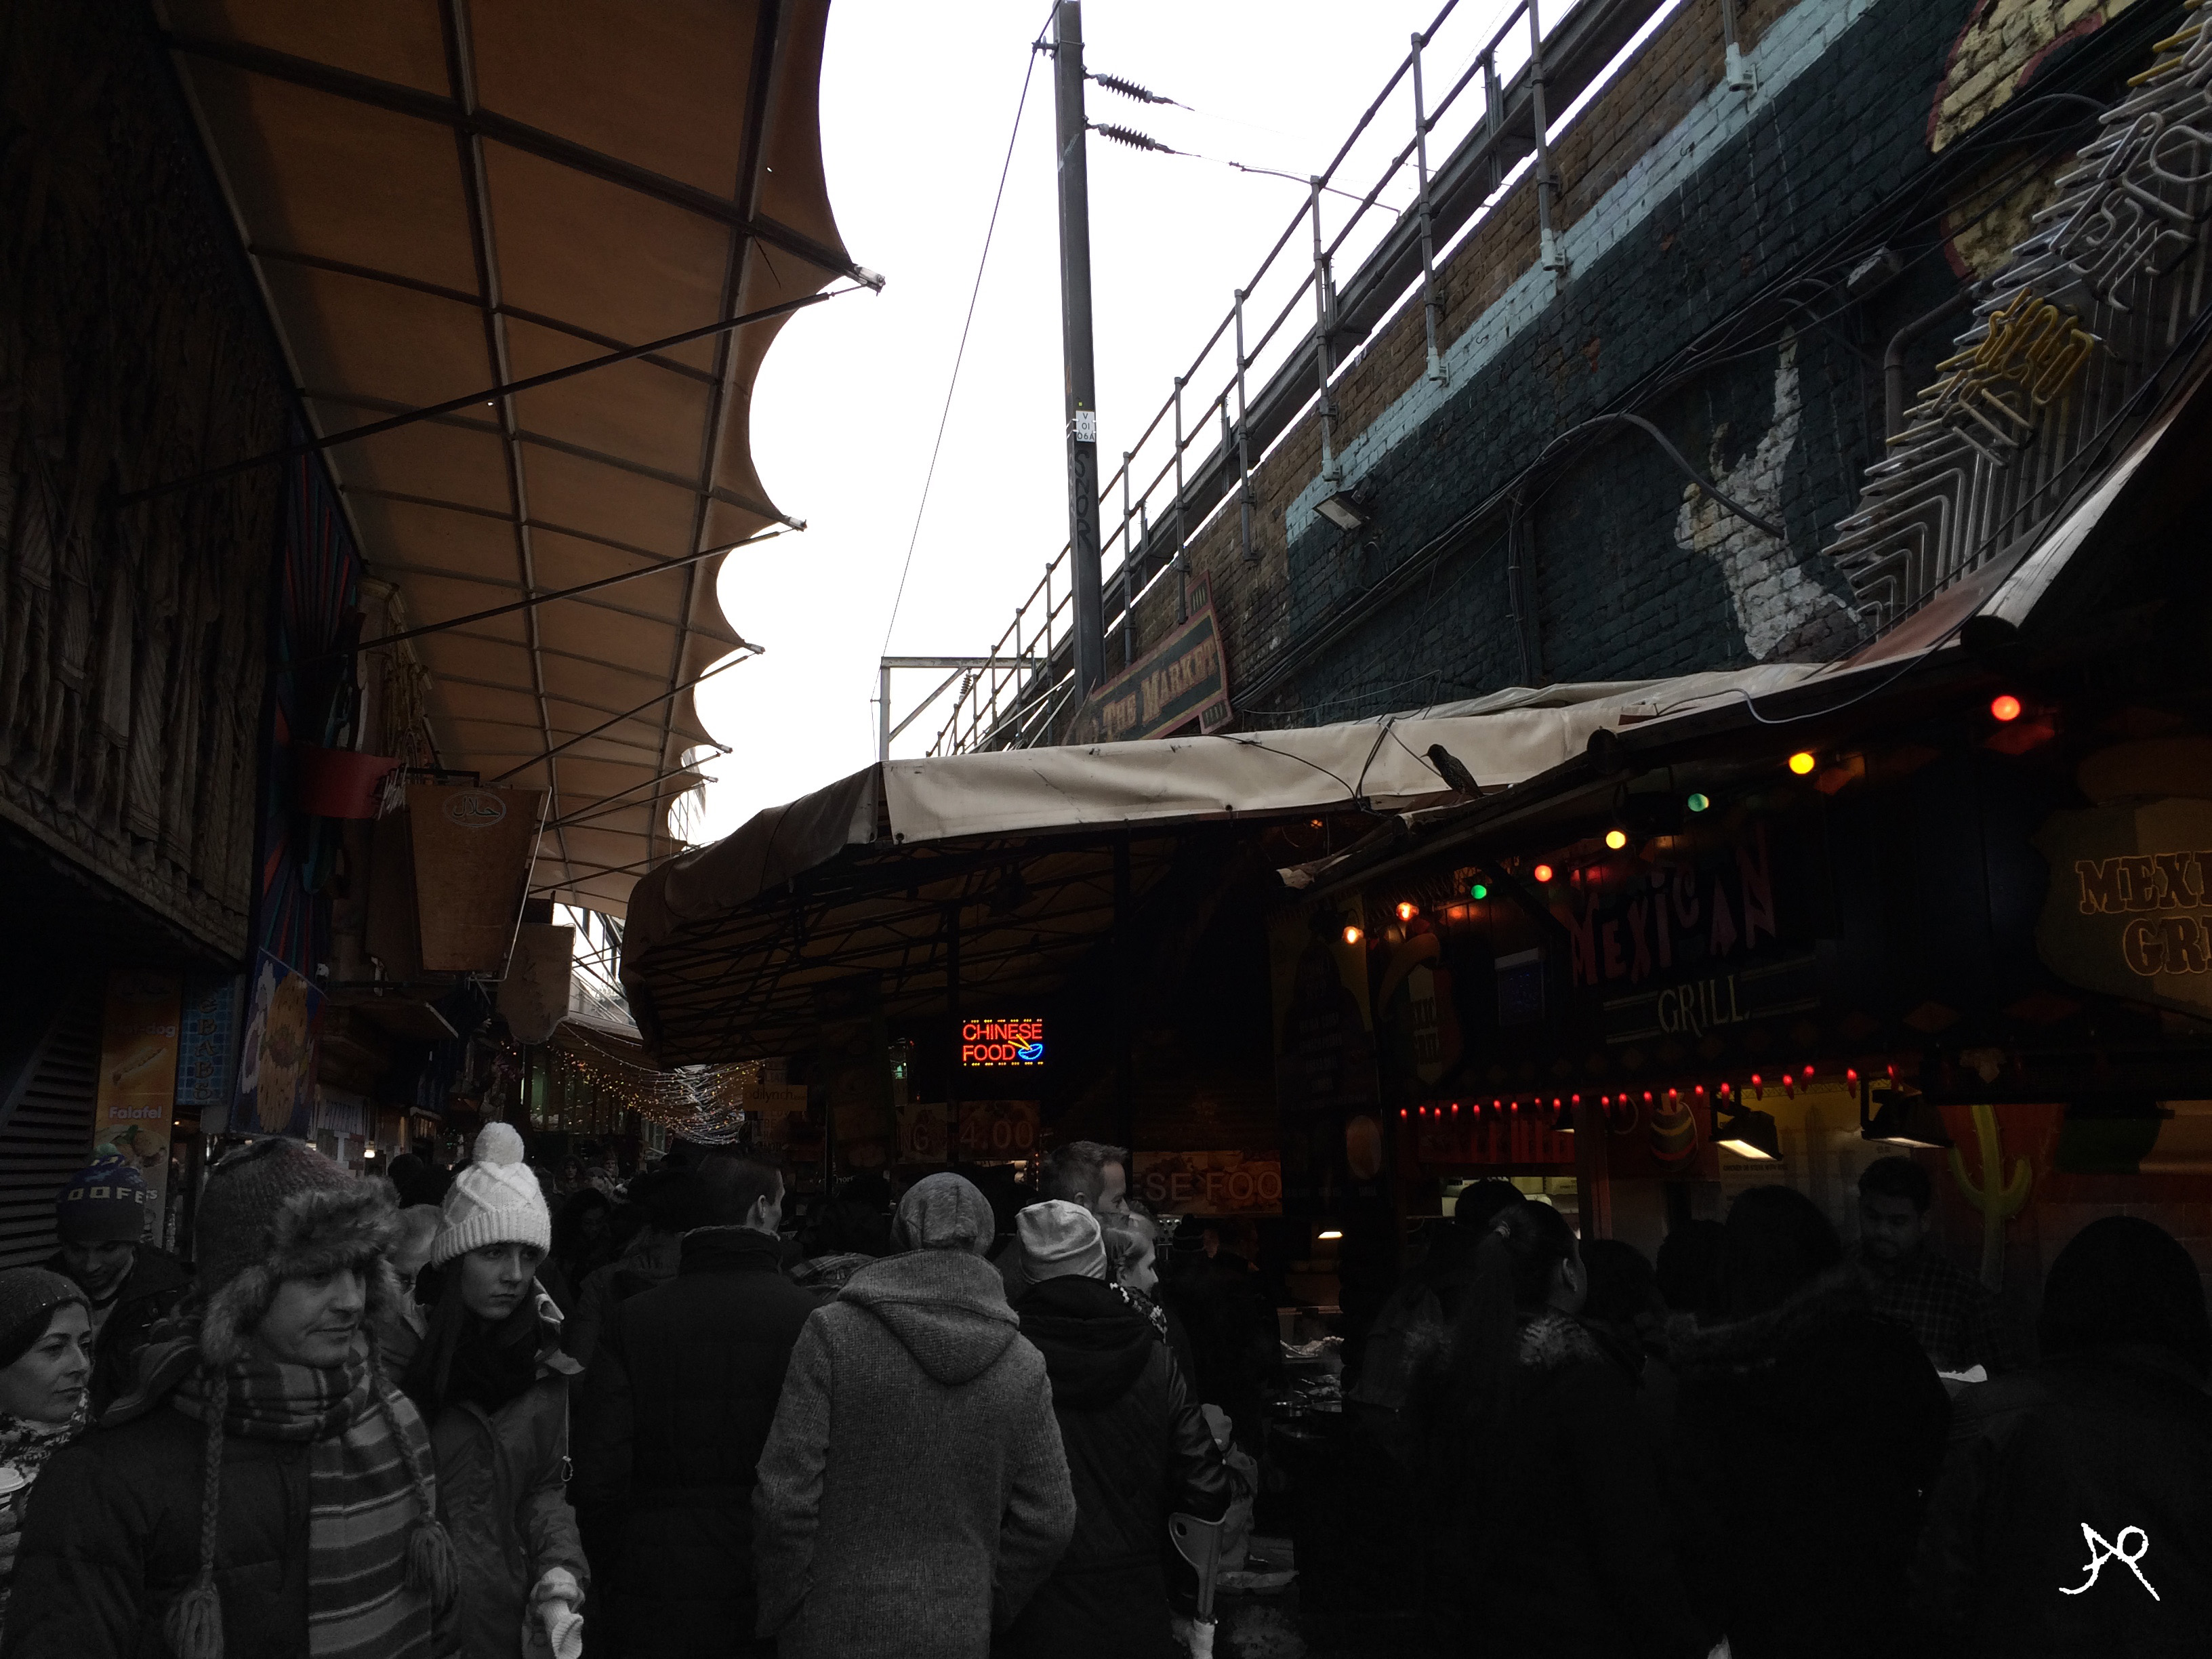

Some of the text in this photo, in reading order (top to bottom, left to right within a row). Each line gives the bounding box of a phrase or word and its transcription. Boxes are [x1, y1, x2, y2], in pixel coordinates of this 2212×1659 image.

[1082, 412, 1088, 420] V
[1077, 432, 1095, 441] 06A
[1141, 634, 1218, 726] MARKET
[1658, 975, 1750, 1038] GRILL
[962, 1023, 1043, 1041] CHINESE
[193, 992, 220, 1101] EBABS
[962, 1044, 1015, 1062] FOOD
[109, 1105, 162, 1119] Falafel
